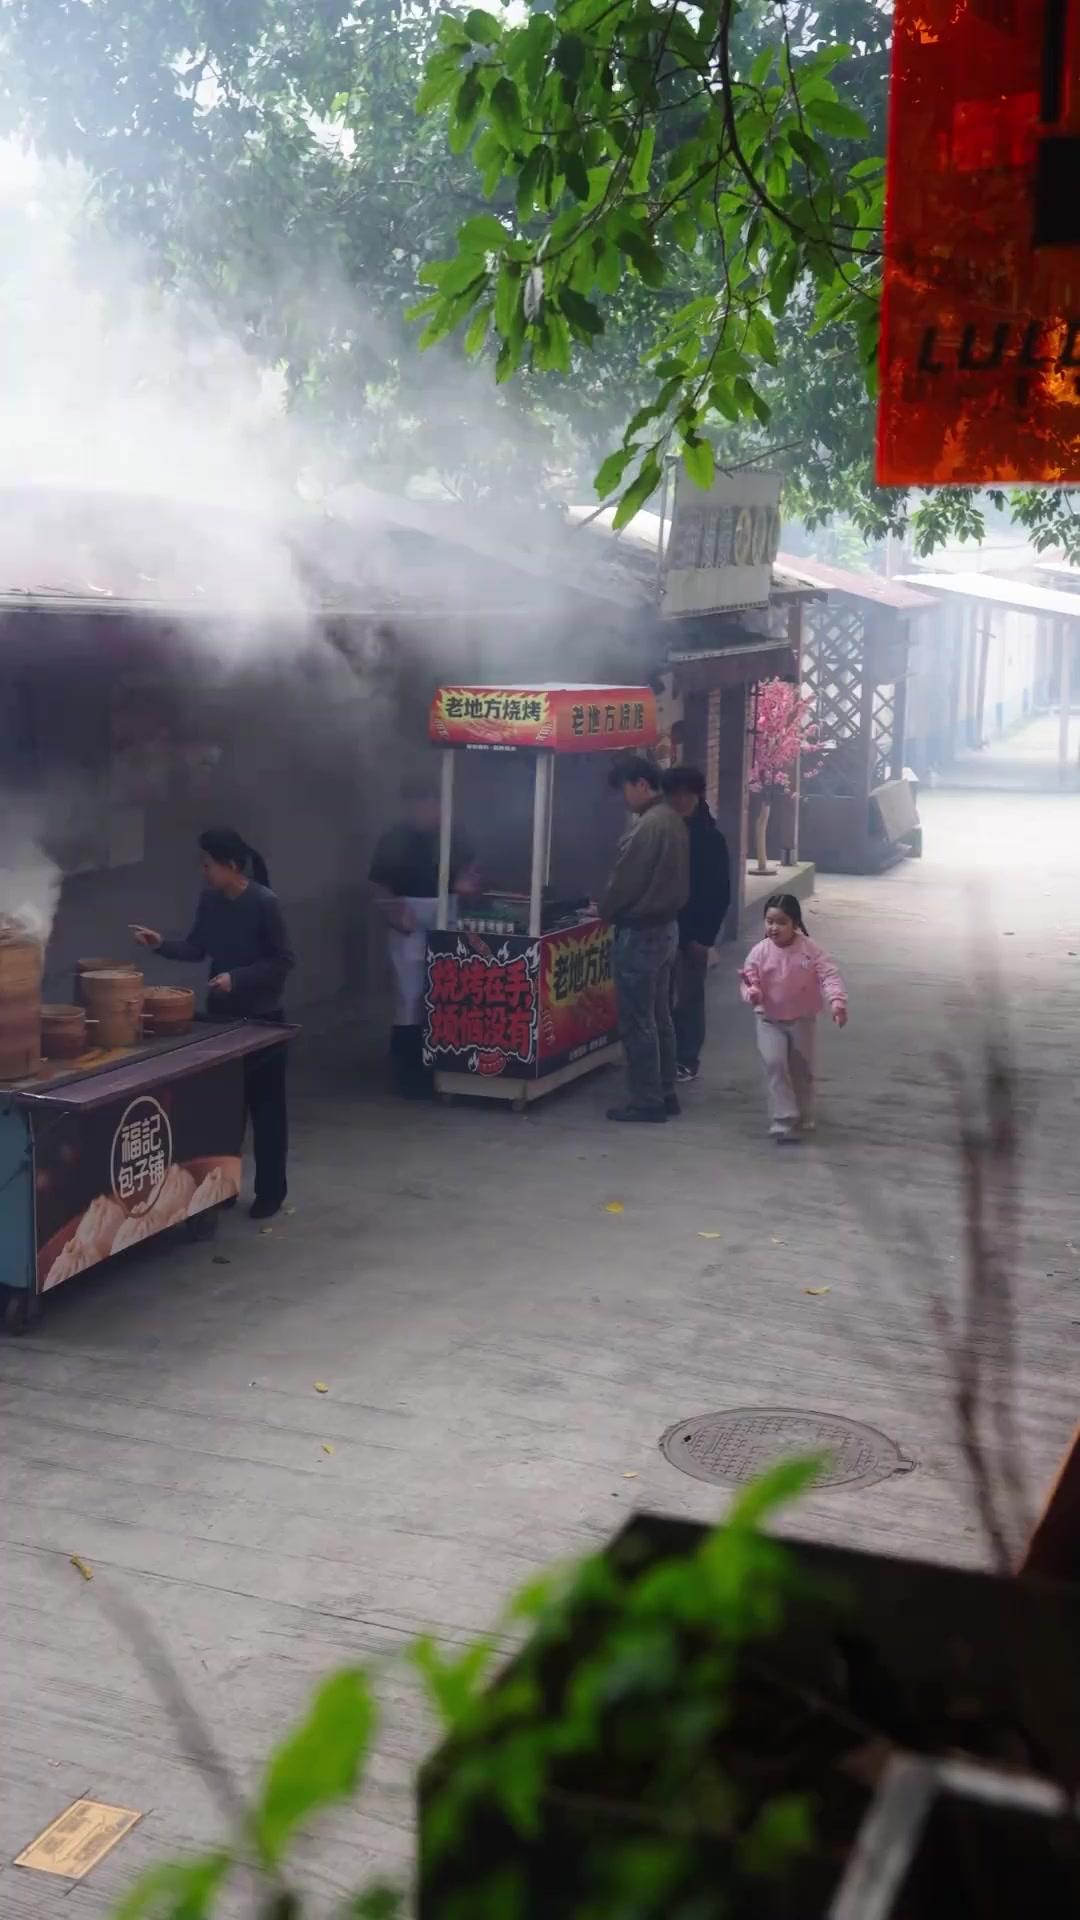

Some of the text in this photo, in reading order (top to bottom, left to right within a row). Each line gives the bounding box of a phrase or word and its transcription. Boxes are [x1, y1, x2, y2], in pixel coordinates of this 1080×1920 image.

[445, 697, 542, 721] 老地方烧烤
[571, 703, 644, 736] 老地方烧烤
[430, 1005, 532, 1056] 烦恼没有
[121, 1114, 162, 1162] 福記
[118, 1150, 165, 1198] 包子铺
